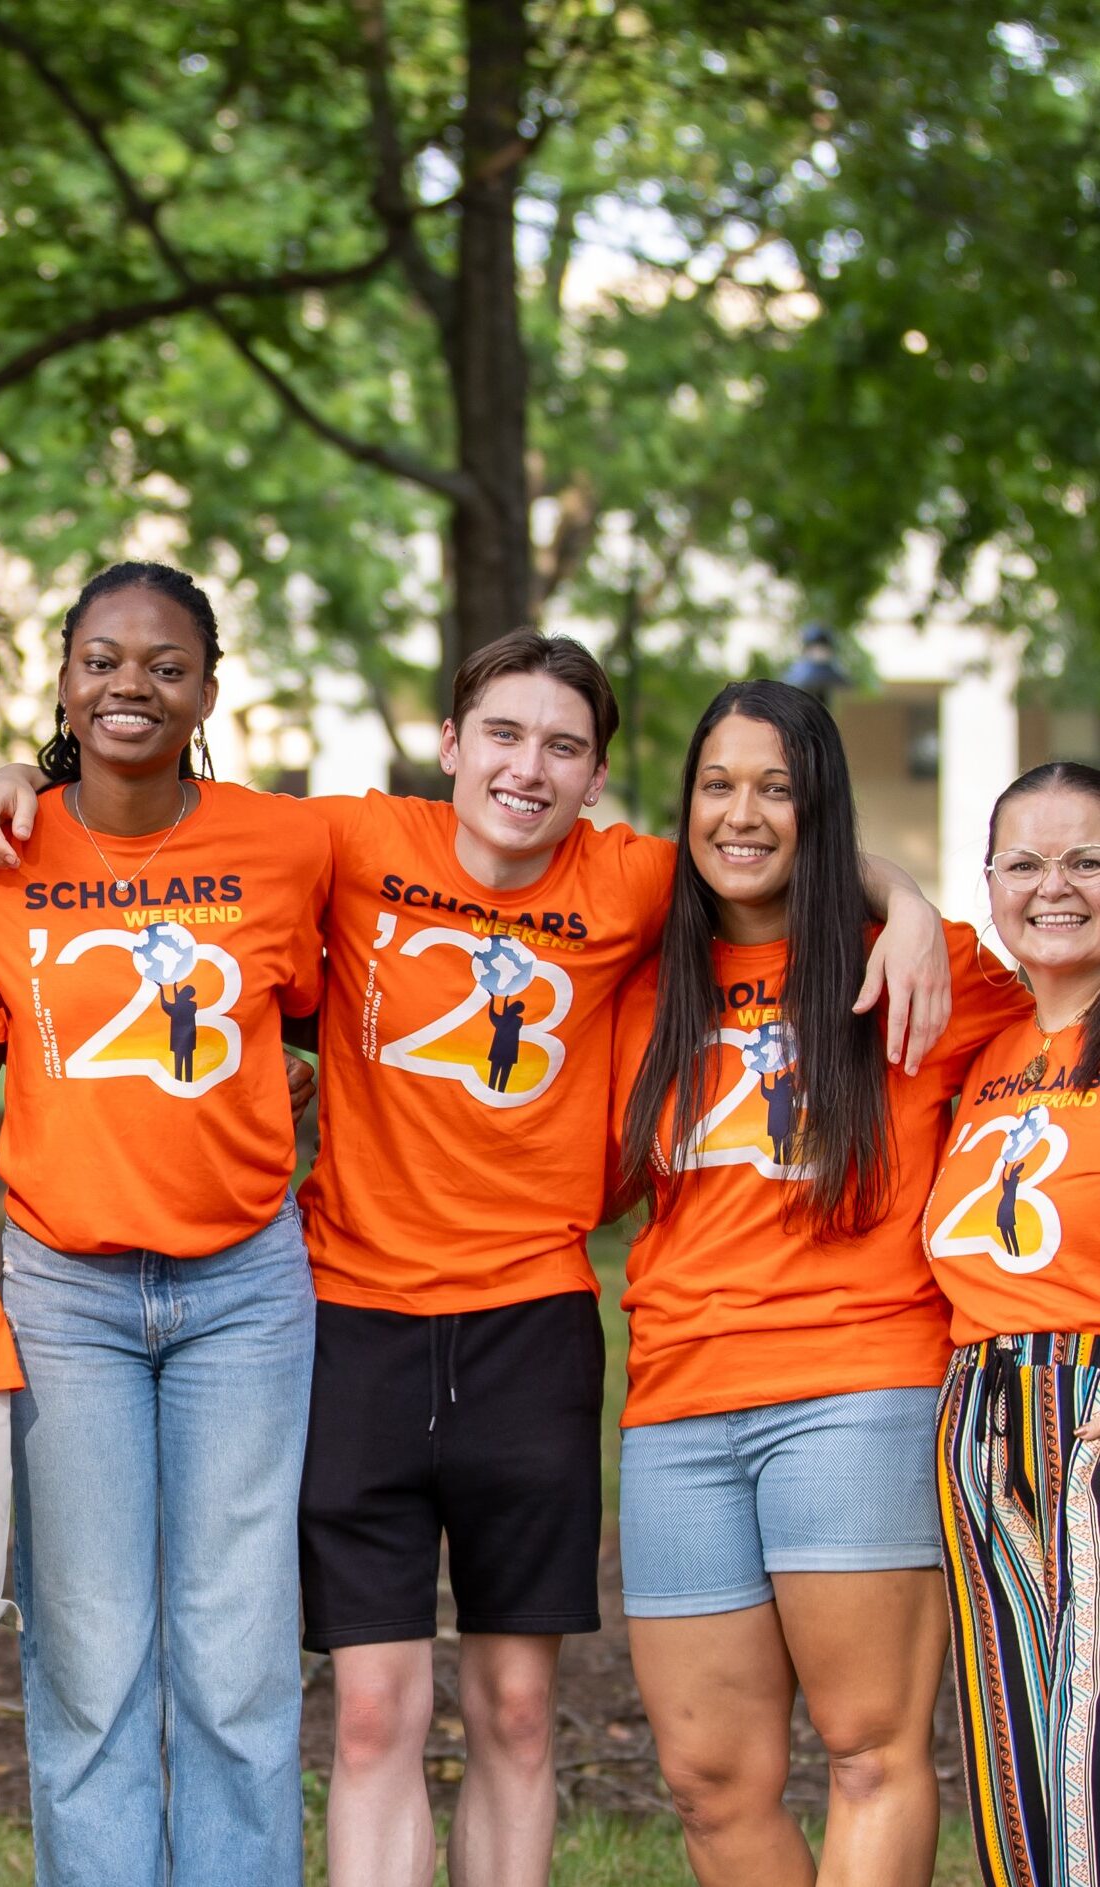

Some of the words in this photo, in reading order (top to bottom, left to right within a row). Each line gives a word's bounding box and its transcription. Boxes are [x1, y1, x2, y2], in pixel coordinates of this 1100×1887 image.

[25, 875, 243, 910] SCHOLARS
[122, 905, 243, 929] WEEKEND
[470, 916, 585, 952] WEEKEND
[365, 959, 378, 998] COOKE
[31, 977, 42, 1018] COOKE
[362, 1000, 371, 1030] KENT
[368, 991, 383, 1061] FOUNDATION
[37, 1020, 51, 1048] KENT
[44, 1008, 63, 1079] FOUNDATION
[361, 1029, 370, 1057] JACK
[43, 1048, 53, 1079] JACK
[1016, 1090, 1098, 1114] WEEKEND
